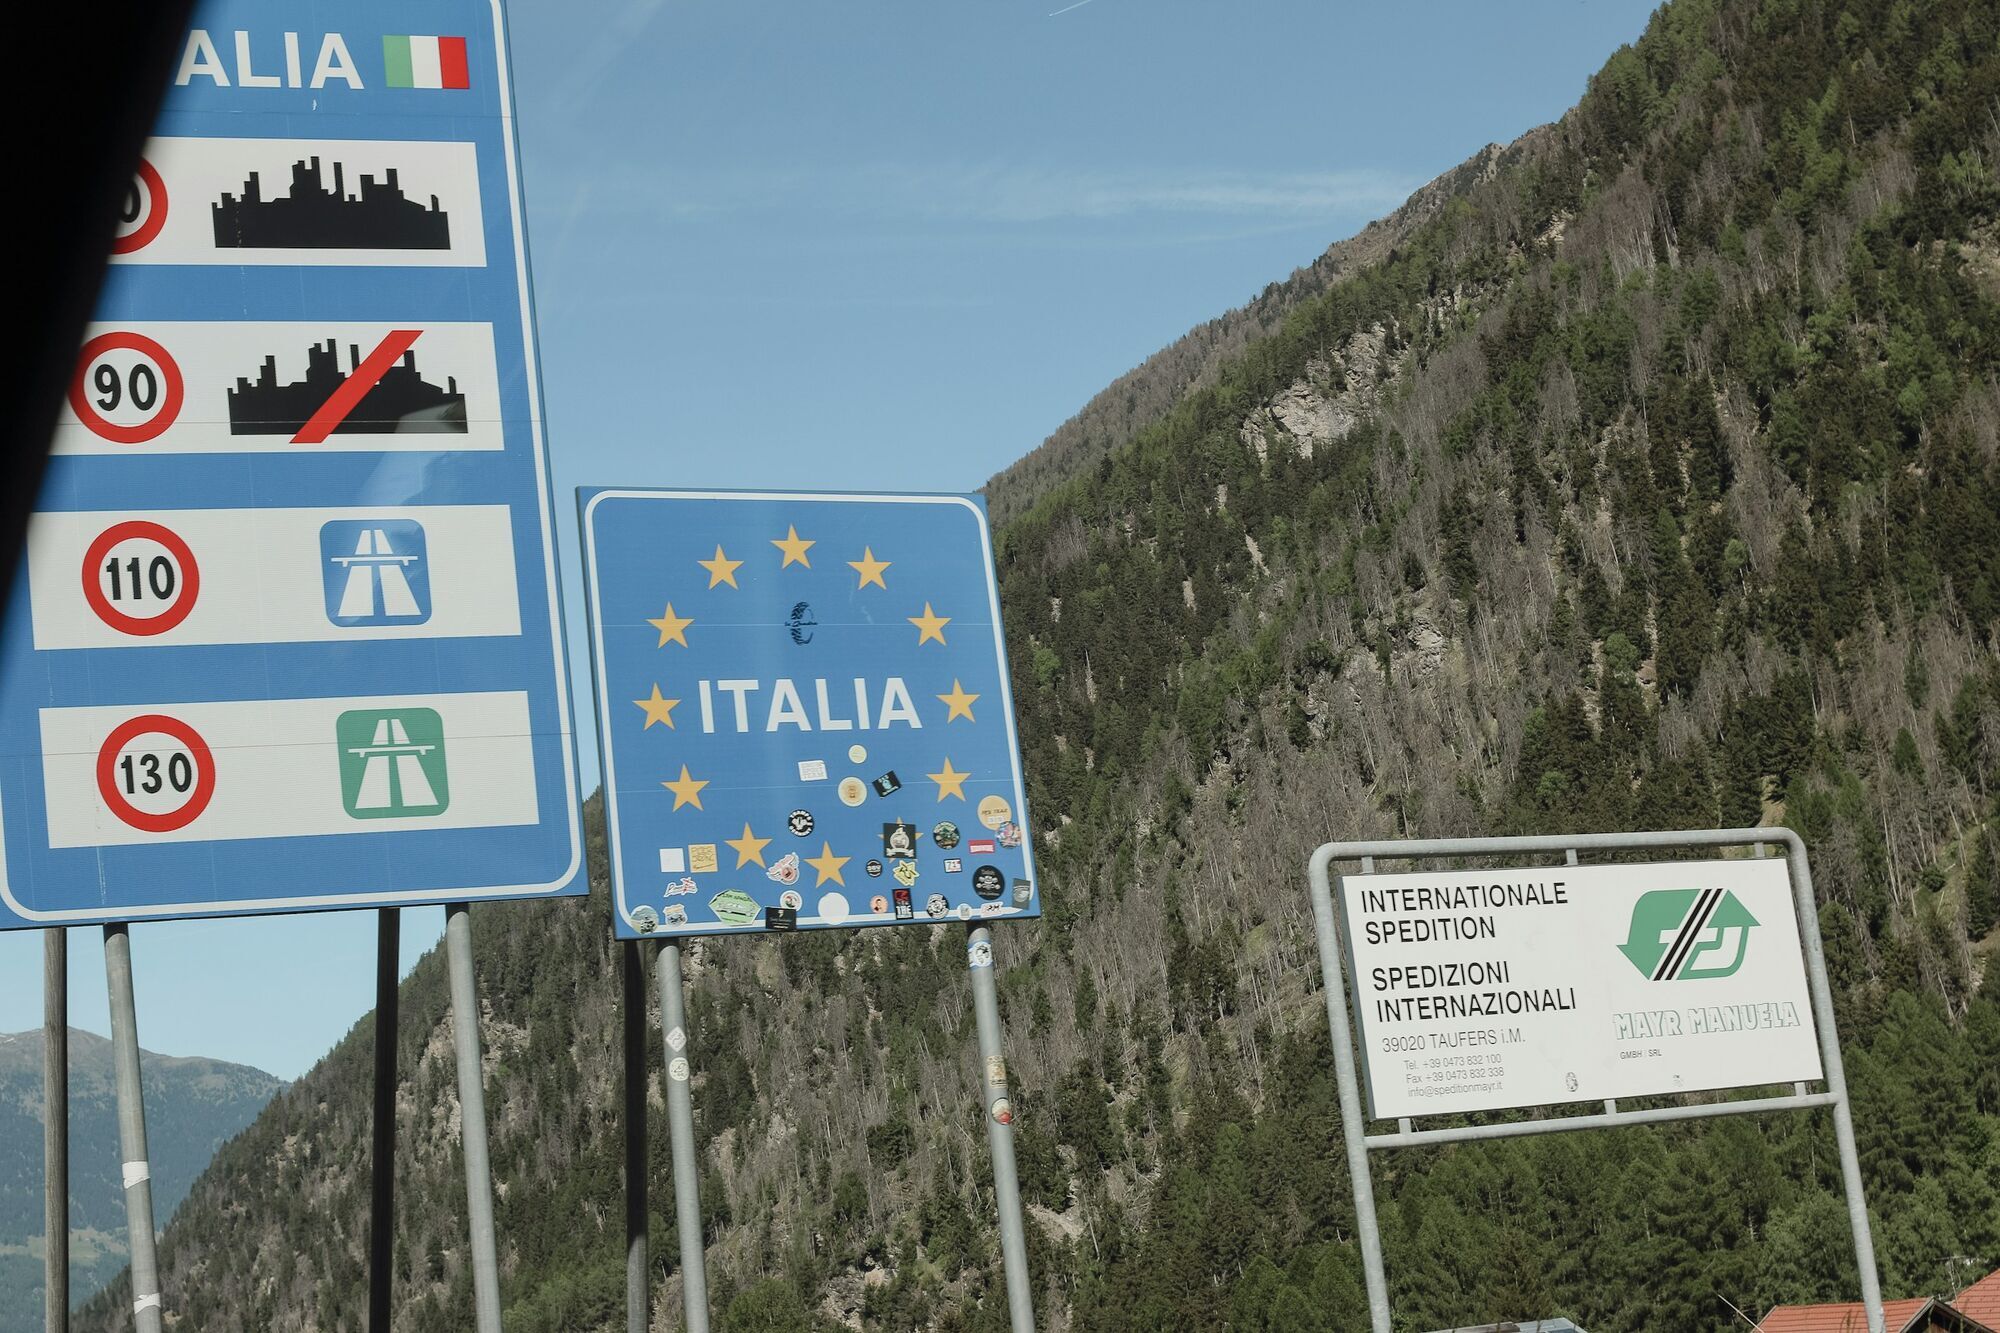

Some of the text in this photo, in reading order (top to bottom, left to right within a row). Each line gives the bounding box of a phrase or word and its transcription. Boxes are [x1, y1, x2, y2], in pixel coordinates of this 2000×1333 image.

[94, 364, 157, 411] 90
[106, 555, 175, 601] 110
[698, 678, 922, 733] ITALIA
[120, 752, 192, 794] 130
[1361, 882, 1568, 913] INTERNATIONALE
[1366, 916, 1496, 944] SPEDITION
[1372, 961, 1510, 991] SPEDIZIONI
[1377, 987, 1576, 1022] INTERNAZIONALI
[1613, 1002, 1800, 1040] MAYR MANUELA
[1382, 1028, 1526, 1053] 39020 TAUFERS i.M.
[1619, 1049, 1662, 1060] GMBH SRL
[1406, 1074, 1423, 1084] Fax
[1425, 1072, 1444, 1082] +39
[1446, 1070, 1468, 1081] 0473
[1469, 1068, 1487, 1079] 832
[1423, 1058, 1441, 1069] +39
[1443, 1056, 1466, 1068] 0473
[1467, 1055, 1484, 1066] 832
[1485, 1053, 1502, 1064] 100
[1408, 1082, 1504, 1098] info@speditionmayr.it
